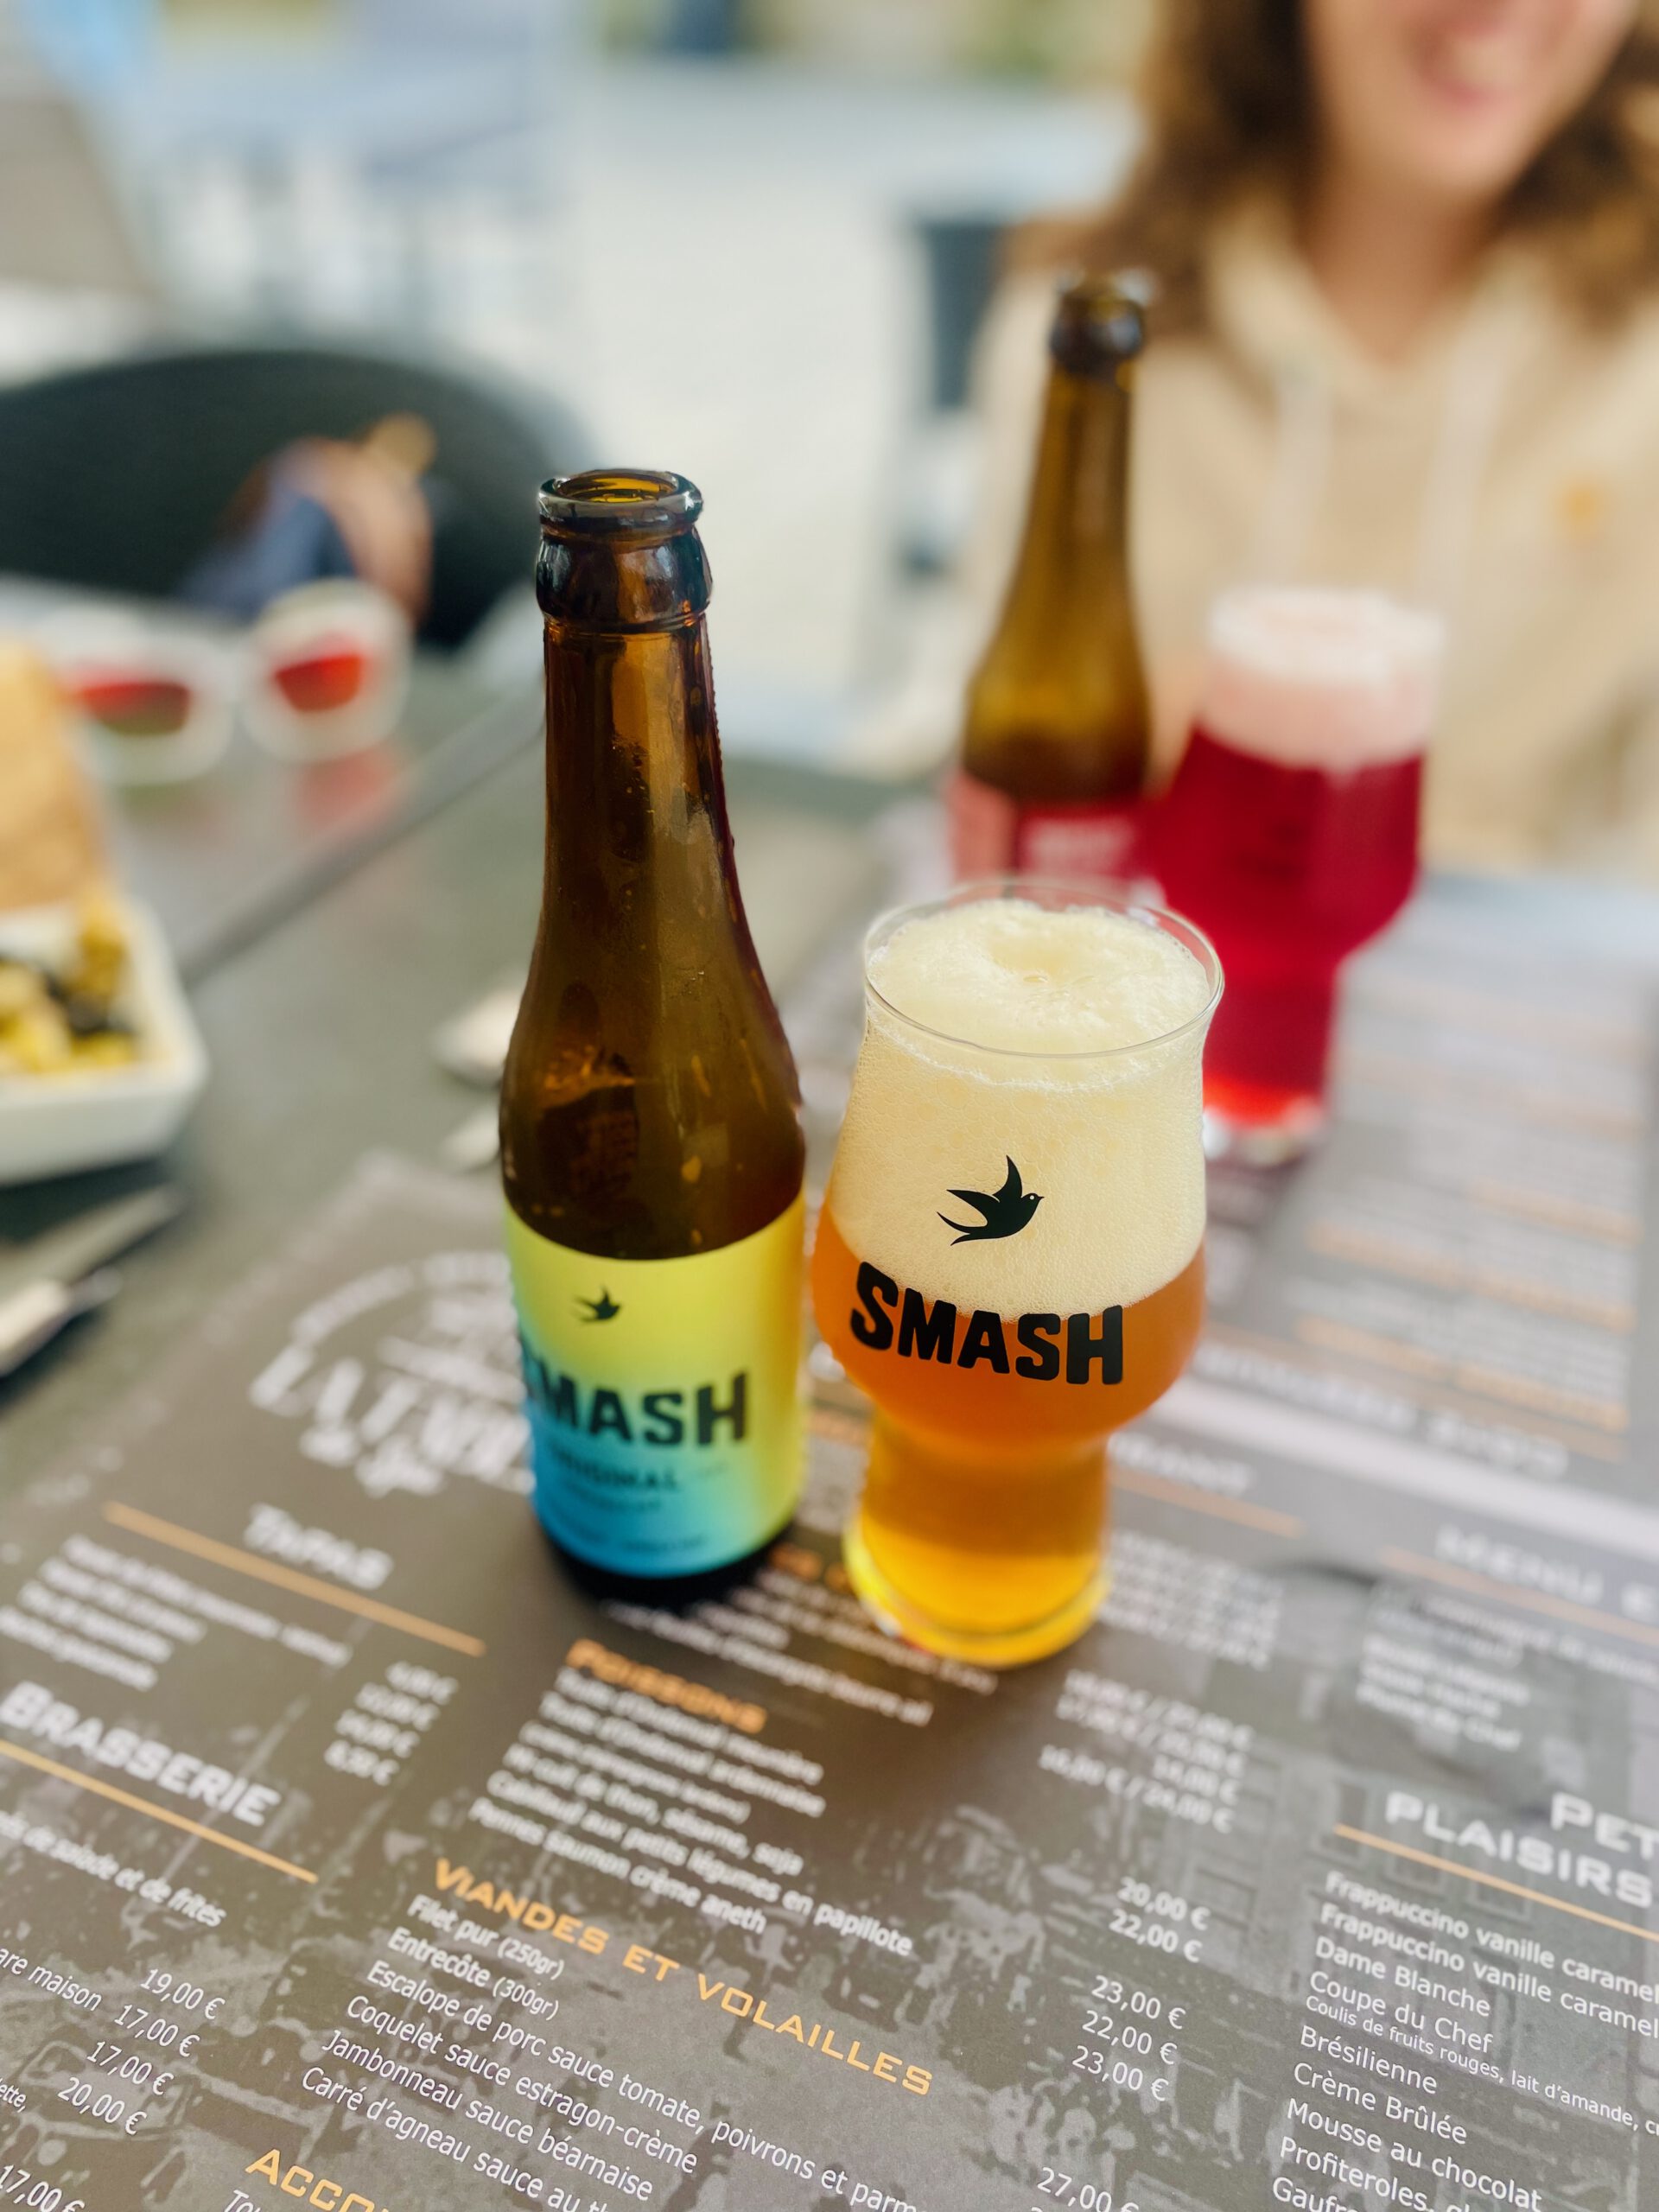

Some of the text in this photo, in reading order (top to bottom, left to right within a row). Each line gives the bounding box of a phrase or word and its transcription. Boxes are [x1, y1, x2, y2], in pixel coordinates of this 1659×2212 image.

[850, 1261, 1124, 1385] SMASH
[0, 1681, 282, 1827] BRASSERIE
[621, 1827, 689, 1866] petits
[687, 1847, 780, 1903] légumes
[782, 1890, 814, 1916] en
[813, 1904, 913, 1956] papillote
[1385, 1790, 1653, 1909] PLAISIRS
[168, 1887, 226, 1927] frites
[407, 1893, 565, 1980] Filet pur (250gr)
[630, 1866, 701, 1908] crème
[700, 1893, 767, 1935] aneth
[1109, 1908, 1204, 1963] 22,00 €
[1117, 1876, 1211, 1931] 20,00 €
[1325, 1870, 1469, 1940] Frappuccino
[1476, 1928, 1554, 1969] vanille
[29, 1966, 102, 2011] maison
[114, 2005, 178, 2047] 17,00
[179, 2035, 200, 2057] €
[140, 1968, 226, 2019] 19,00 €
[388, 1926, 559, 2021] Entrecôte (300gr)
[435, 1858, 933, 2095] VIANDES ET VOLAILLES
[1091, 1974, 1186, 2030] 23,00 €
[1310, 1970, 1494, 2054] Coupe du Chef
[1315, 1936, 1491, 2017] Dame Blanche
[1320, 1902, 1659, 2039] Frappuccino vanille caramel
[87, 2041, 174, 2095] 17,00 €
[367, 1960, 461, 2018] Escalope
[463, 2005, 493, 2032] de
[493, 2021, 547, 2056] porc
[548, 2045, 614, 2088] sauce
[619, 2074, 704, 2135] tomate,
[711, 2120, 816, 2180] poivrons
[821, 2168, 849, 2196] et
[1071, 2044, 1169, 2101] 23,00 €
[1082, 2010, 1178, 2065] 22,00 €
[1300, 2025, 1437, 2094] Brésilienne
[1306, 1995, 1357, 2026] Coulis
[1363, 2018, 1383, 2037] de
[1389, 2026, 1434, 2055] fruits
[1440, 2047, 1504, 2084] rouges,
[1512, 2070, 1540, 2094] lait
[1545, 2084, 1639, 2131] d'amande,
[58, 2077, 147, 2135] 20,00 €
[321, 2030, 653, 2201] Jambonneau sauce béarnaise
[347, 1995, 697, 2173] Coquelet sauce estragon-crème
[1294, 2063, 1467, 2145] Crème Brûlée
[302, 2067, 581, 2212] Carré d'agneau sauce au
[1287, 2098, 1541, 2212] Mousse au chocolat
[0, 2164, 62, 2212] 17,00
[1037, 2166, 1112, 2212] 27,00
